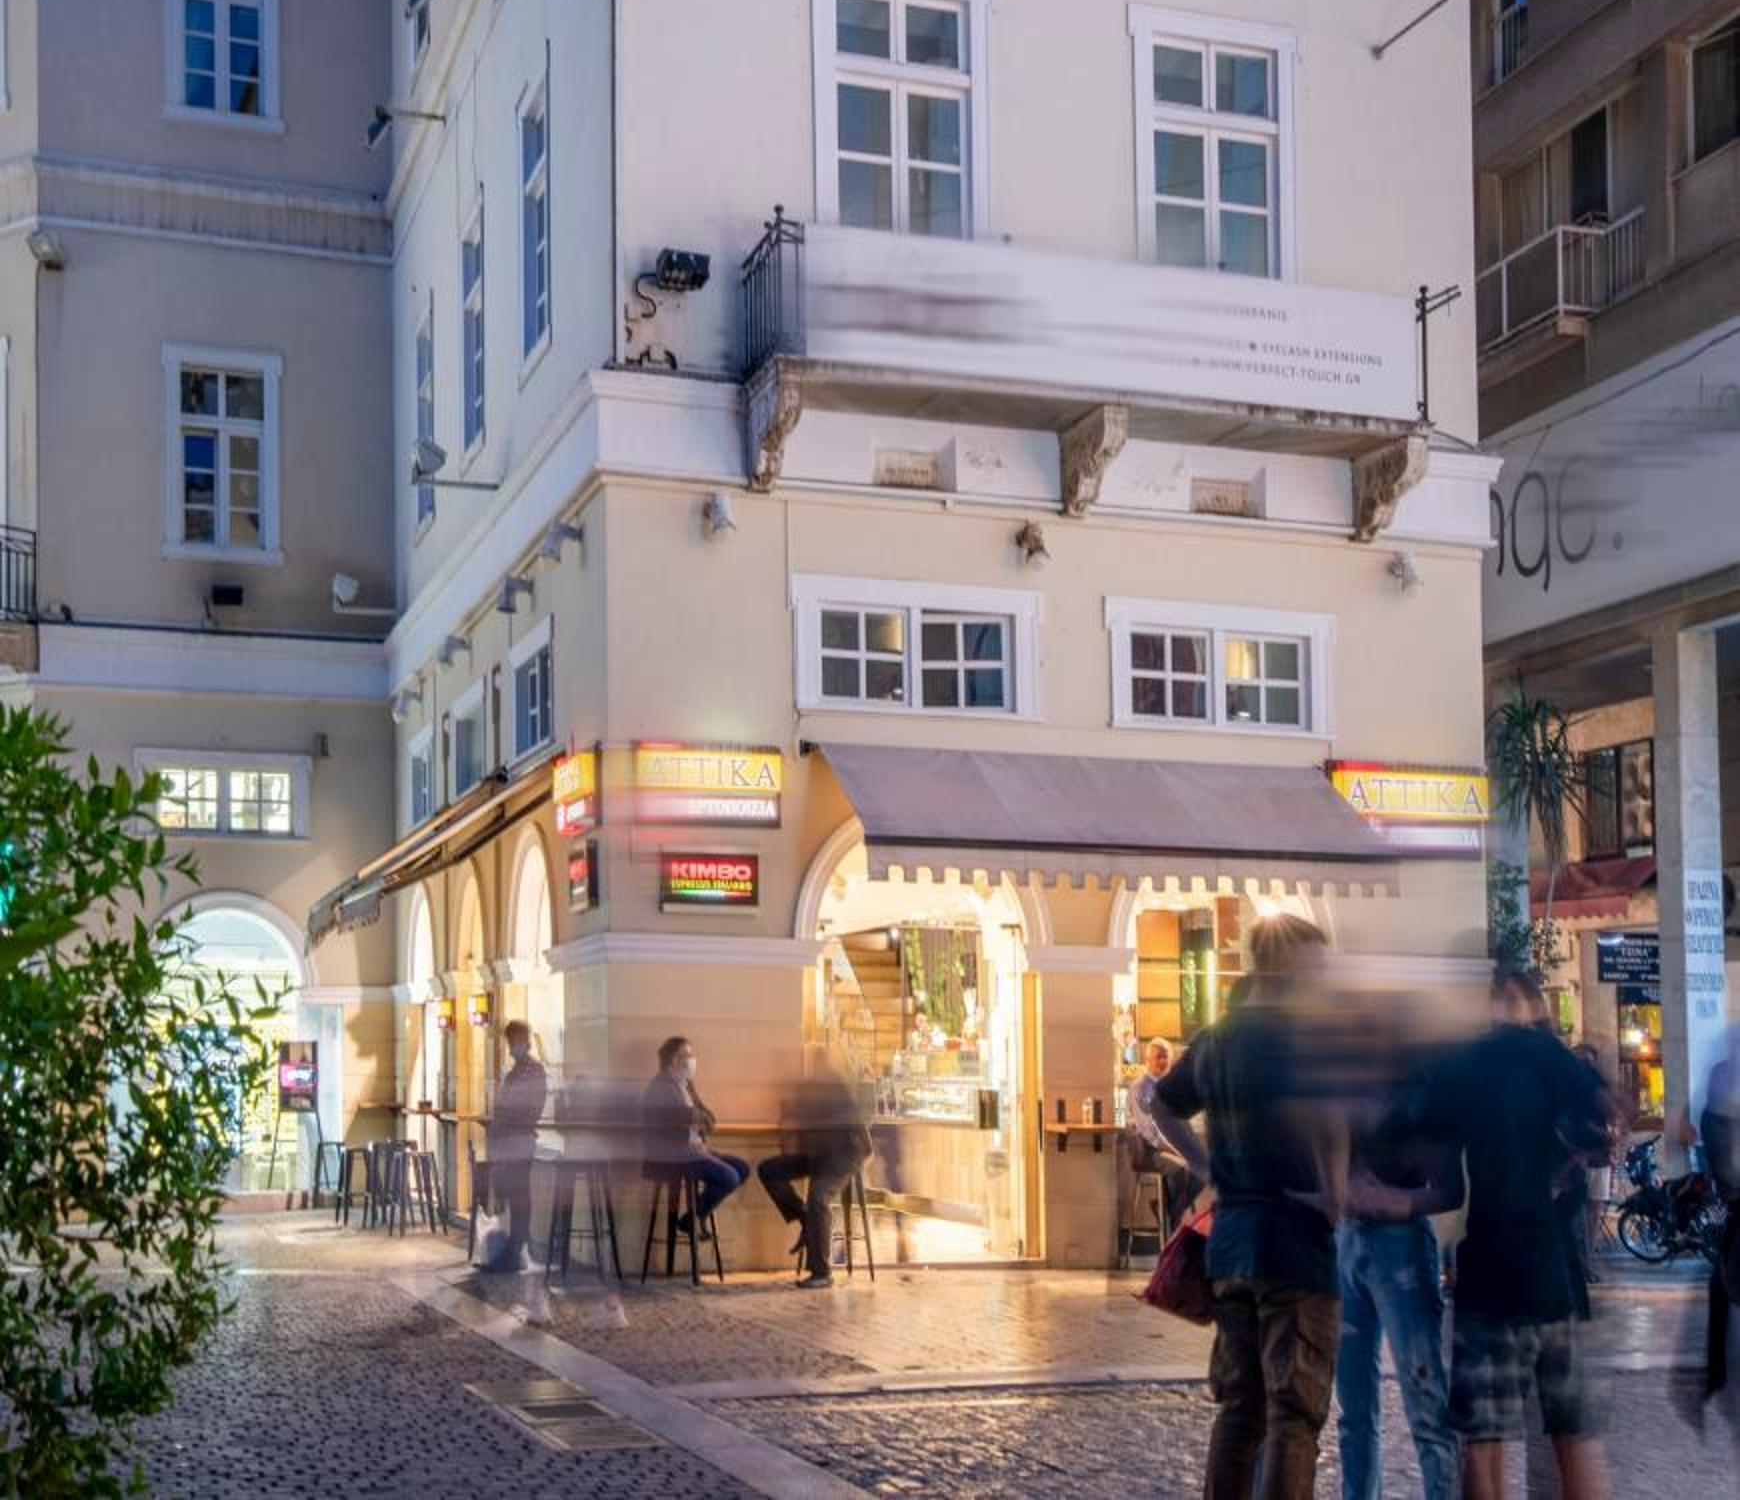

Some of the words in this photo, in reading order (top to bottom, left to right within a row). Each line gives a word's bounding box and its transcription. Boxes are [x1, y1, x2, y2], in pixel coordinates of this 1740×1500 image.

[1262, 344, 1310, 357] EYELASH
[1314, 347, 1383, 366] EXTENSIONS
[646, 756, 777, 787] ATTIKA
[1350, 777, 1484, 815] ATTIKA
[671, 861, 752, 880] KIMBO
